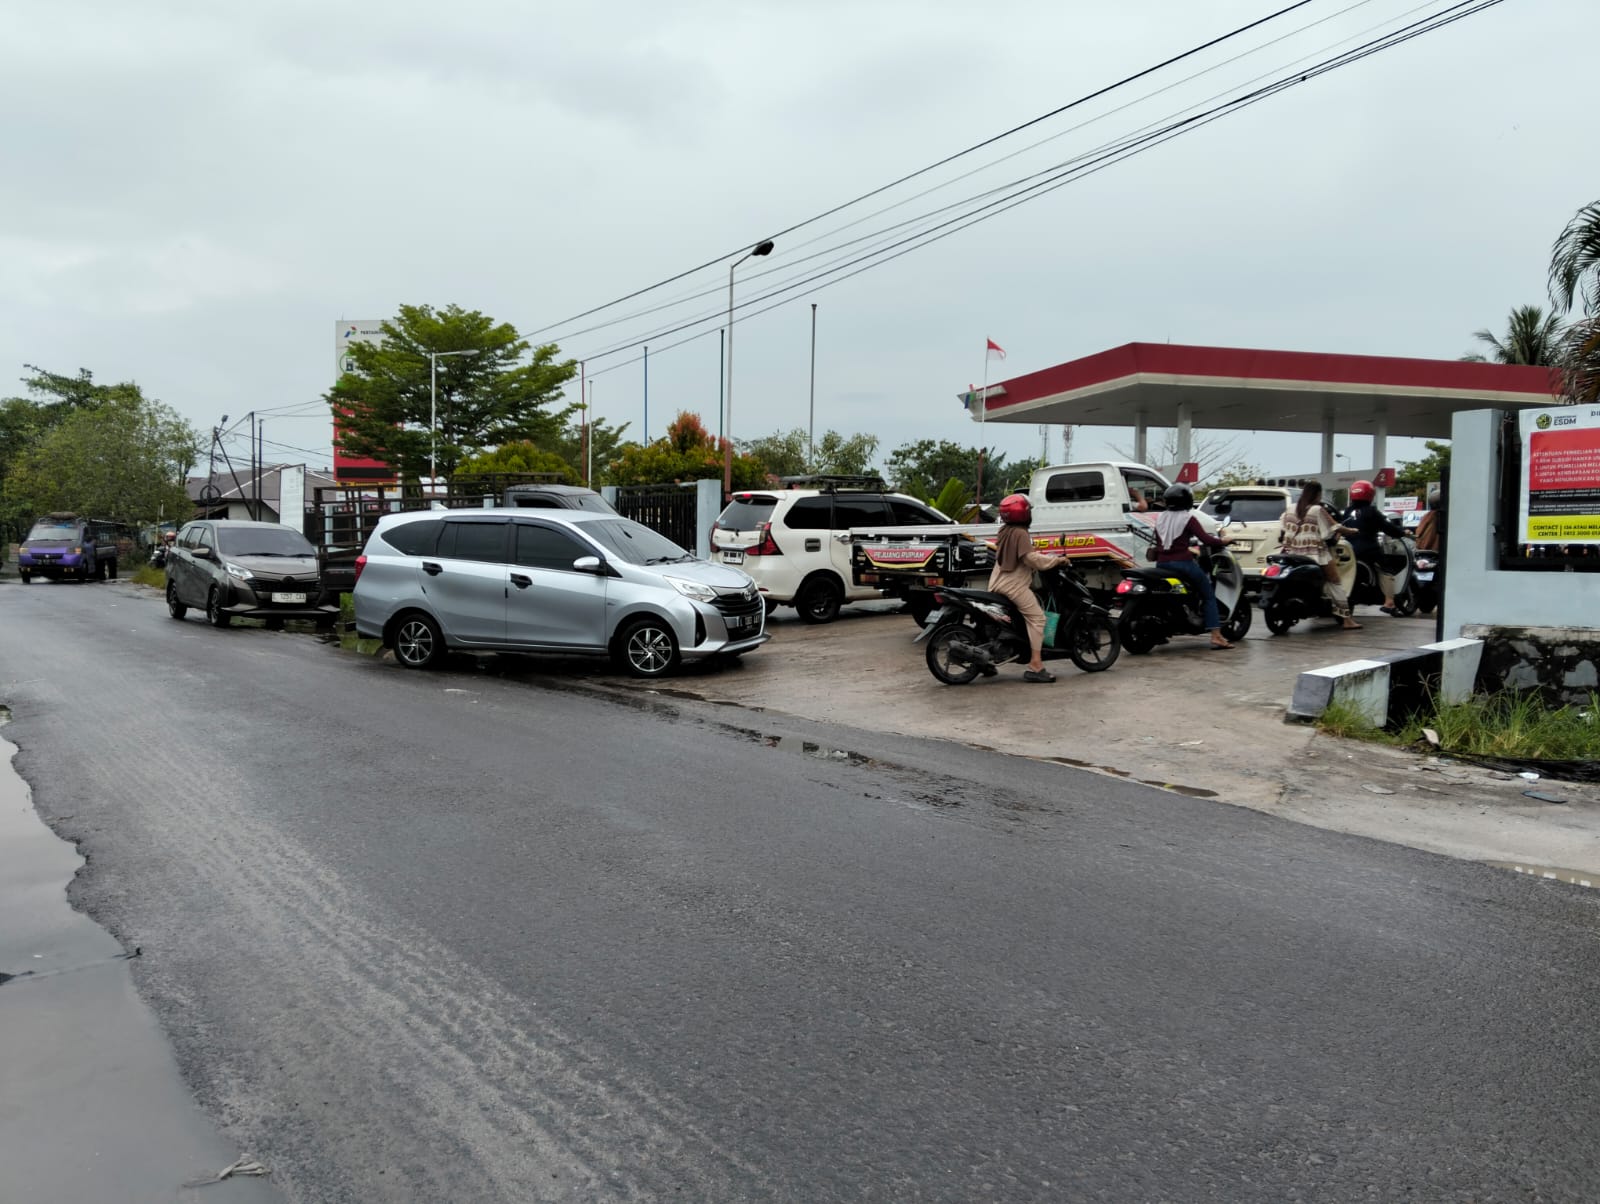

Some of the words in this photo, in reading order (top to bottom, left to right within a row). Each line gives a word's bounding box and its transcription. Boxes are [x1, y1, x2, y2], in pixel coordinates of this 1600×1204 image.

[1553, 418, 1577, 426] ESDM
[1183, 468, 1188, 477] 1
[873, 551, 900, 559] PEJUANG
